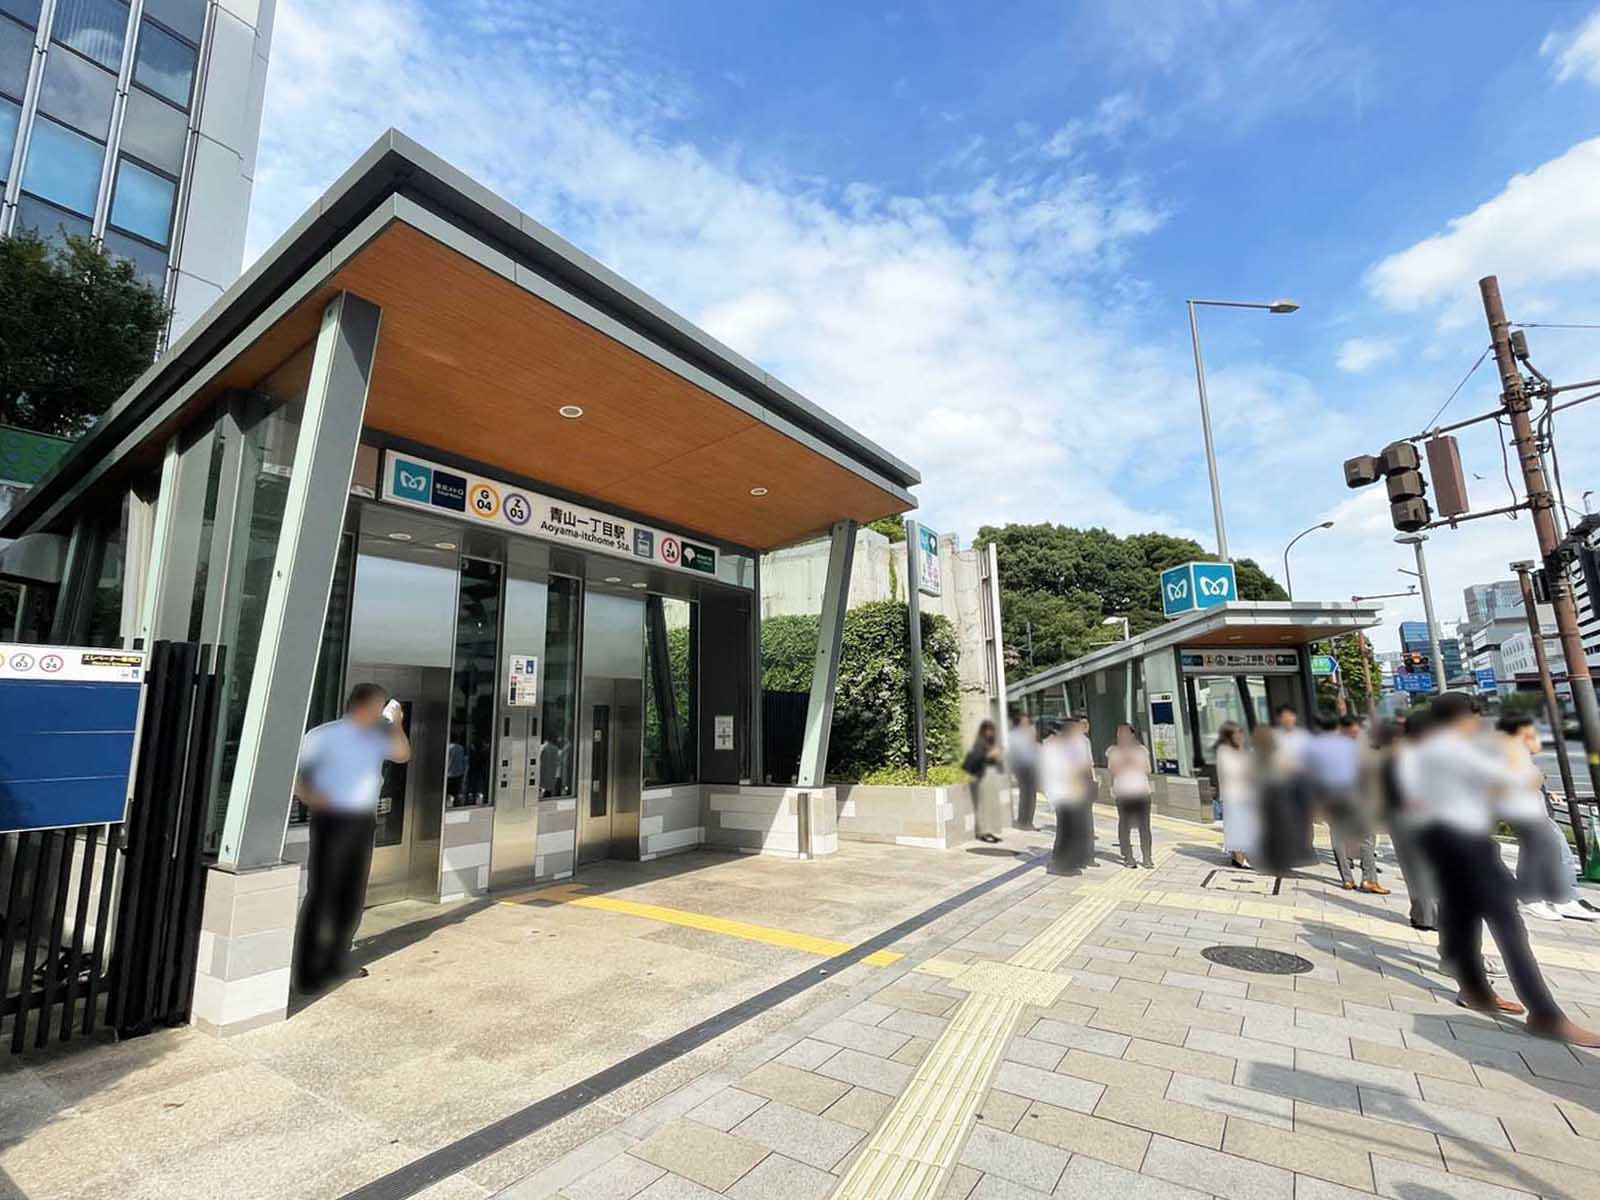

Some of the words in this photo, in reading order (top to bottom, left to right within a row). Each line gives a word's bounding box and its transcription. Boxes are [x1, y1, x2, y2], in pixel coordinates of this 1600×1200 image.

[480, 489, 489, 500] G
[476, 499, 492, 512] 04
[514, 499, 521, 509] Z
[510, 508, 524, 520] 03
[550, 506, 625, 540] 青山一丁目駅
[540, 521, 615, 548] Aoyama-itchome
[616, 539, 632, 552] Sta.
